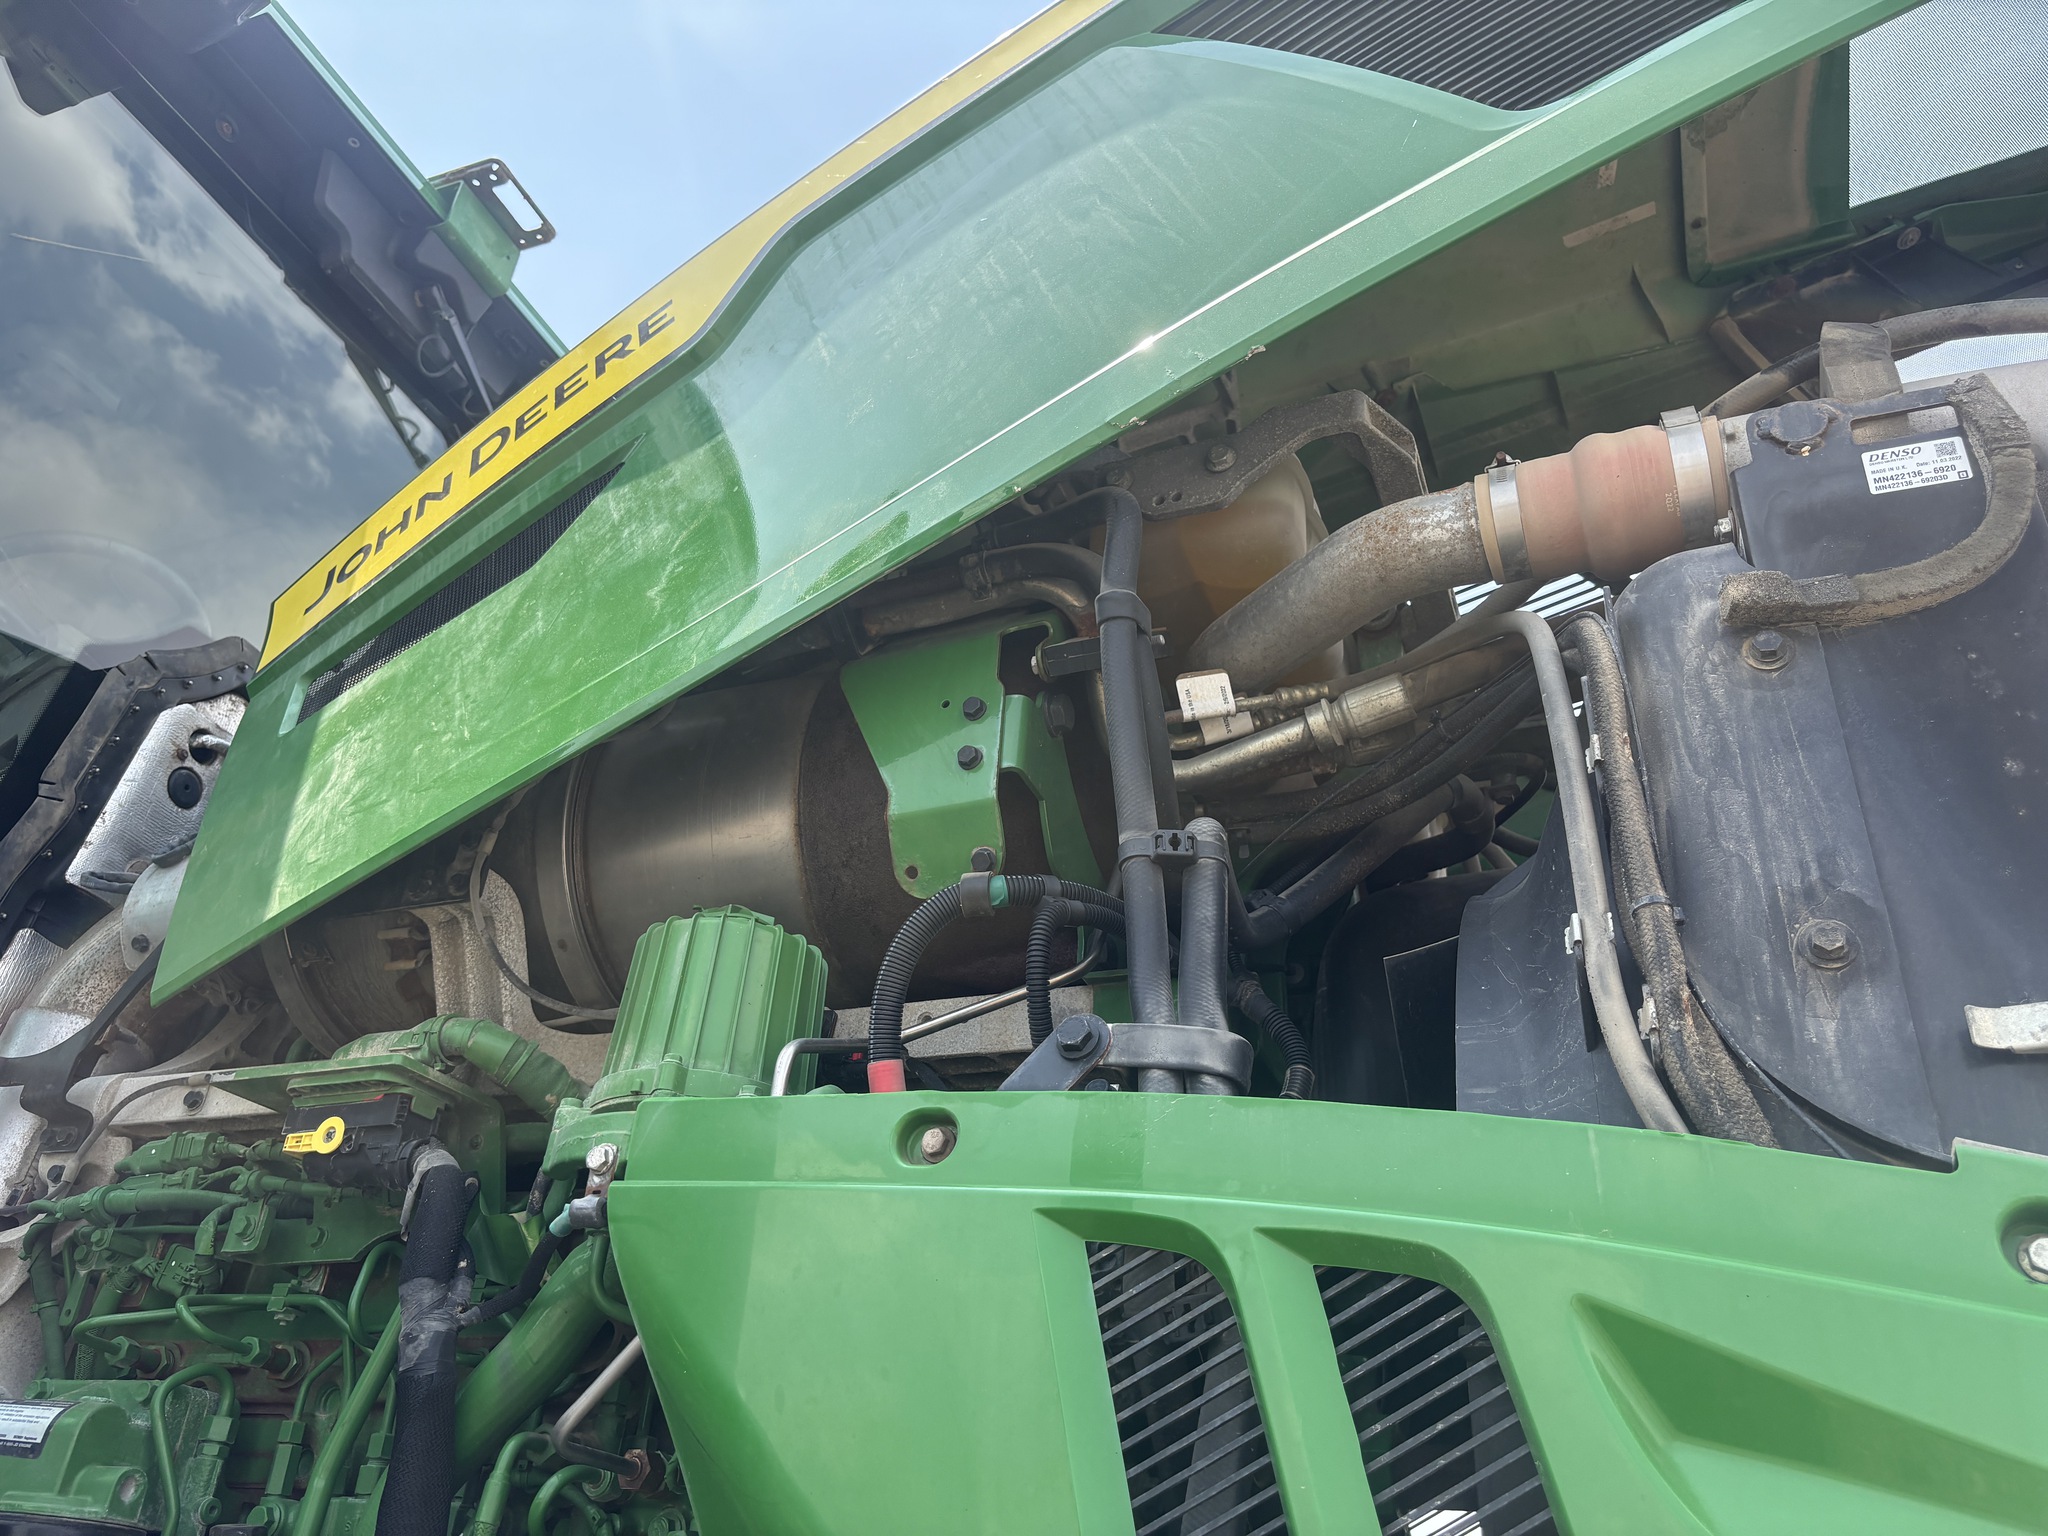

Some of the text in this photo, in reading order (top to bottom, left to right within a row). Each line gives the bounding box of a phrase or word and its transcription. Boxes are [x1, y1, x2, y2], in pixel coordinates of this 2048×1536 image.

[303, 300, 675, 616] JOHN DEERE
[1869, 446, 1922, 462] DENSO
[1871, 467, 1887, 475] MADE
